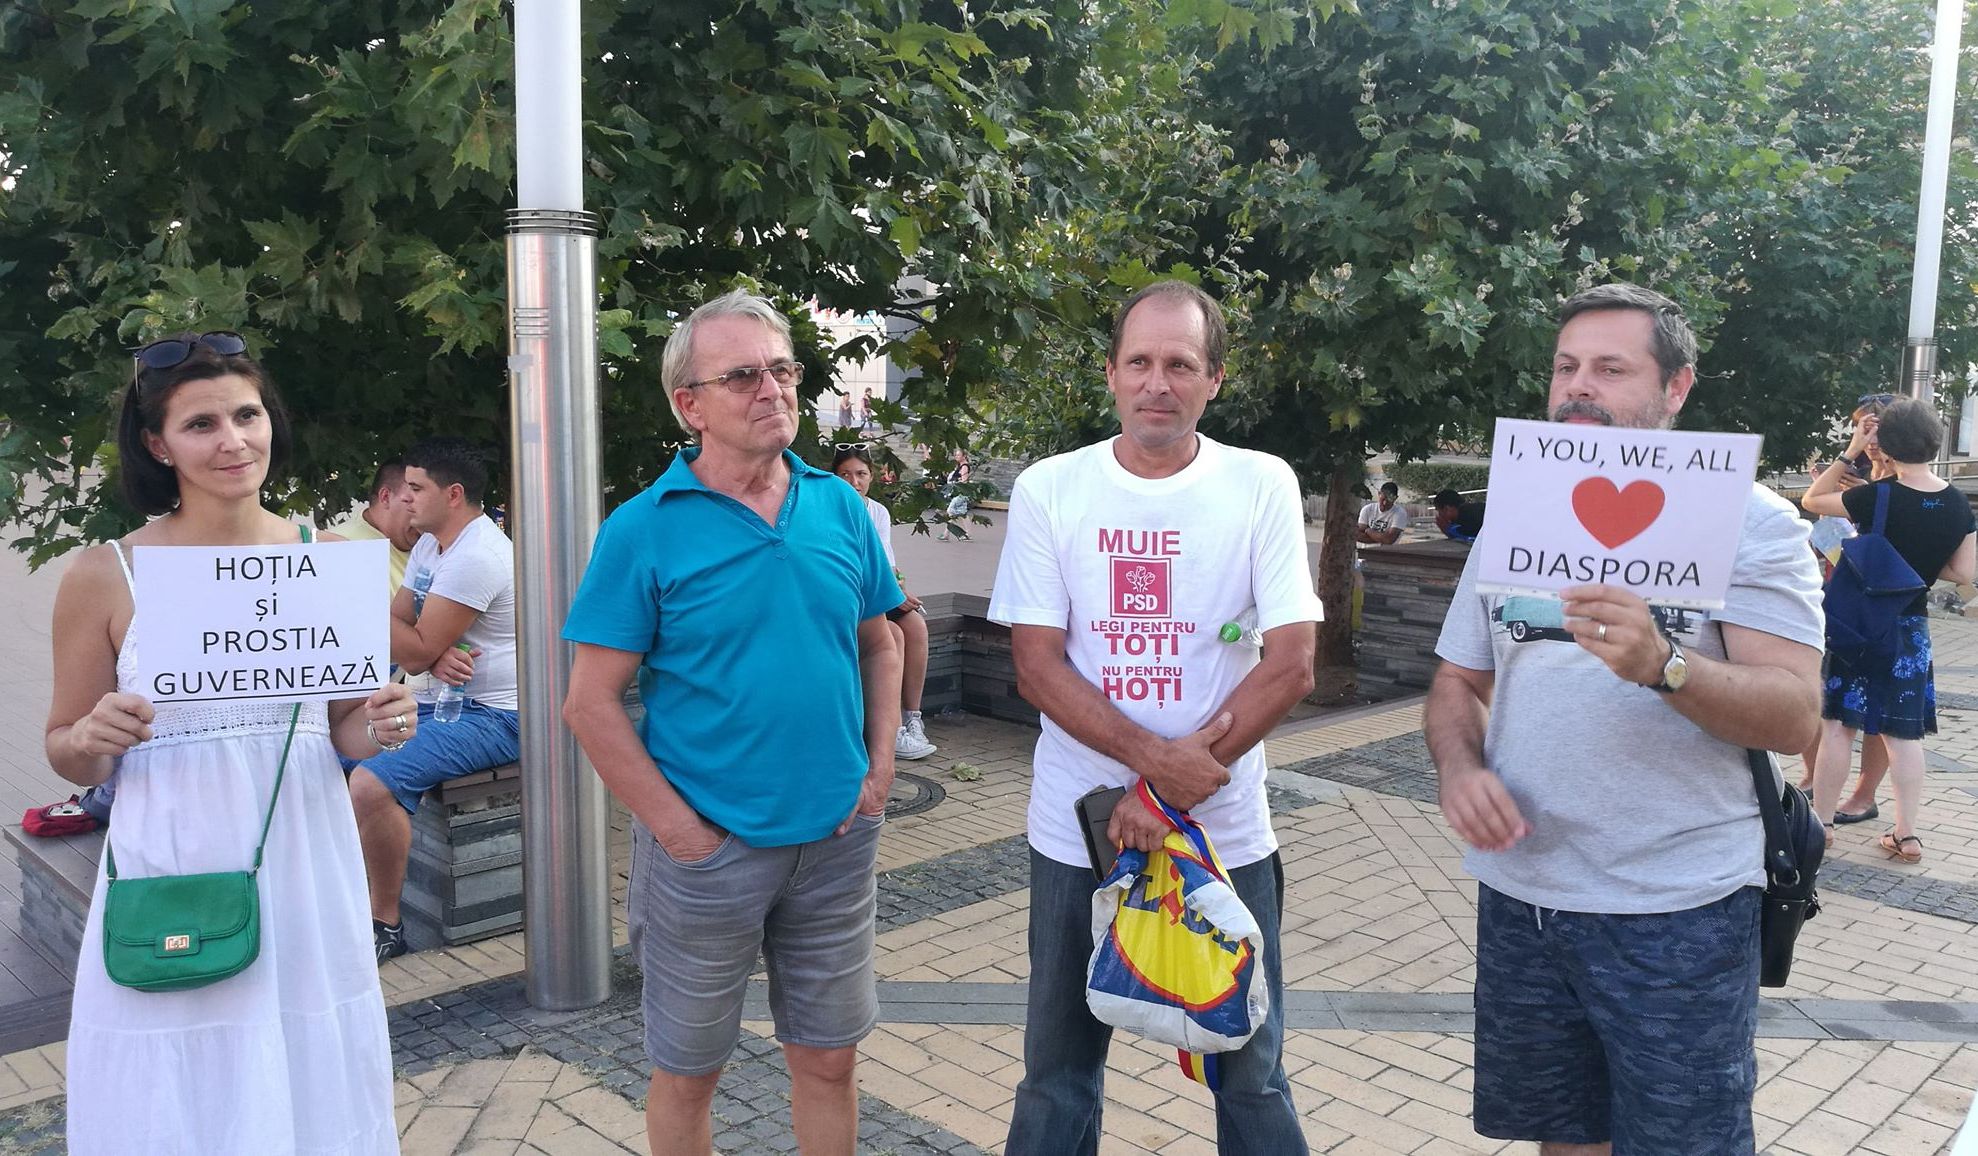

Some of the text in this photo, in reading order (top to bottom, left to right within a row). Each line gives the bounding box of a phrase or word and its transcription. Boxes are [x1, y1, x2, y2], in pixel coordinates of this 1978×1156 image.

[1508, 434, 1738, 474] I, YOU, WE, ALL
[1098, 528, 1181, 556] MUIE
[1507, 546, 1701, 587] DIASPORA
[1123, 593, 1158, 611] PSD
[202, 625, 340, 655] PROSTIA
[1091, 620, 1196, 634] LEGI PENTRU
[153, 655, 379, 696] GUVERNEAZĂ
[1102, 666, 1183, 677] NU PENTRU
